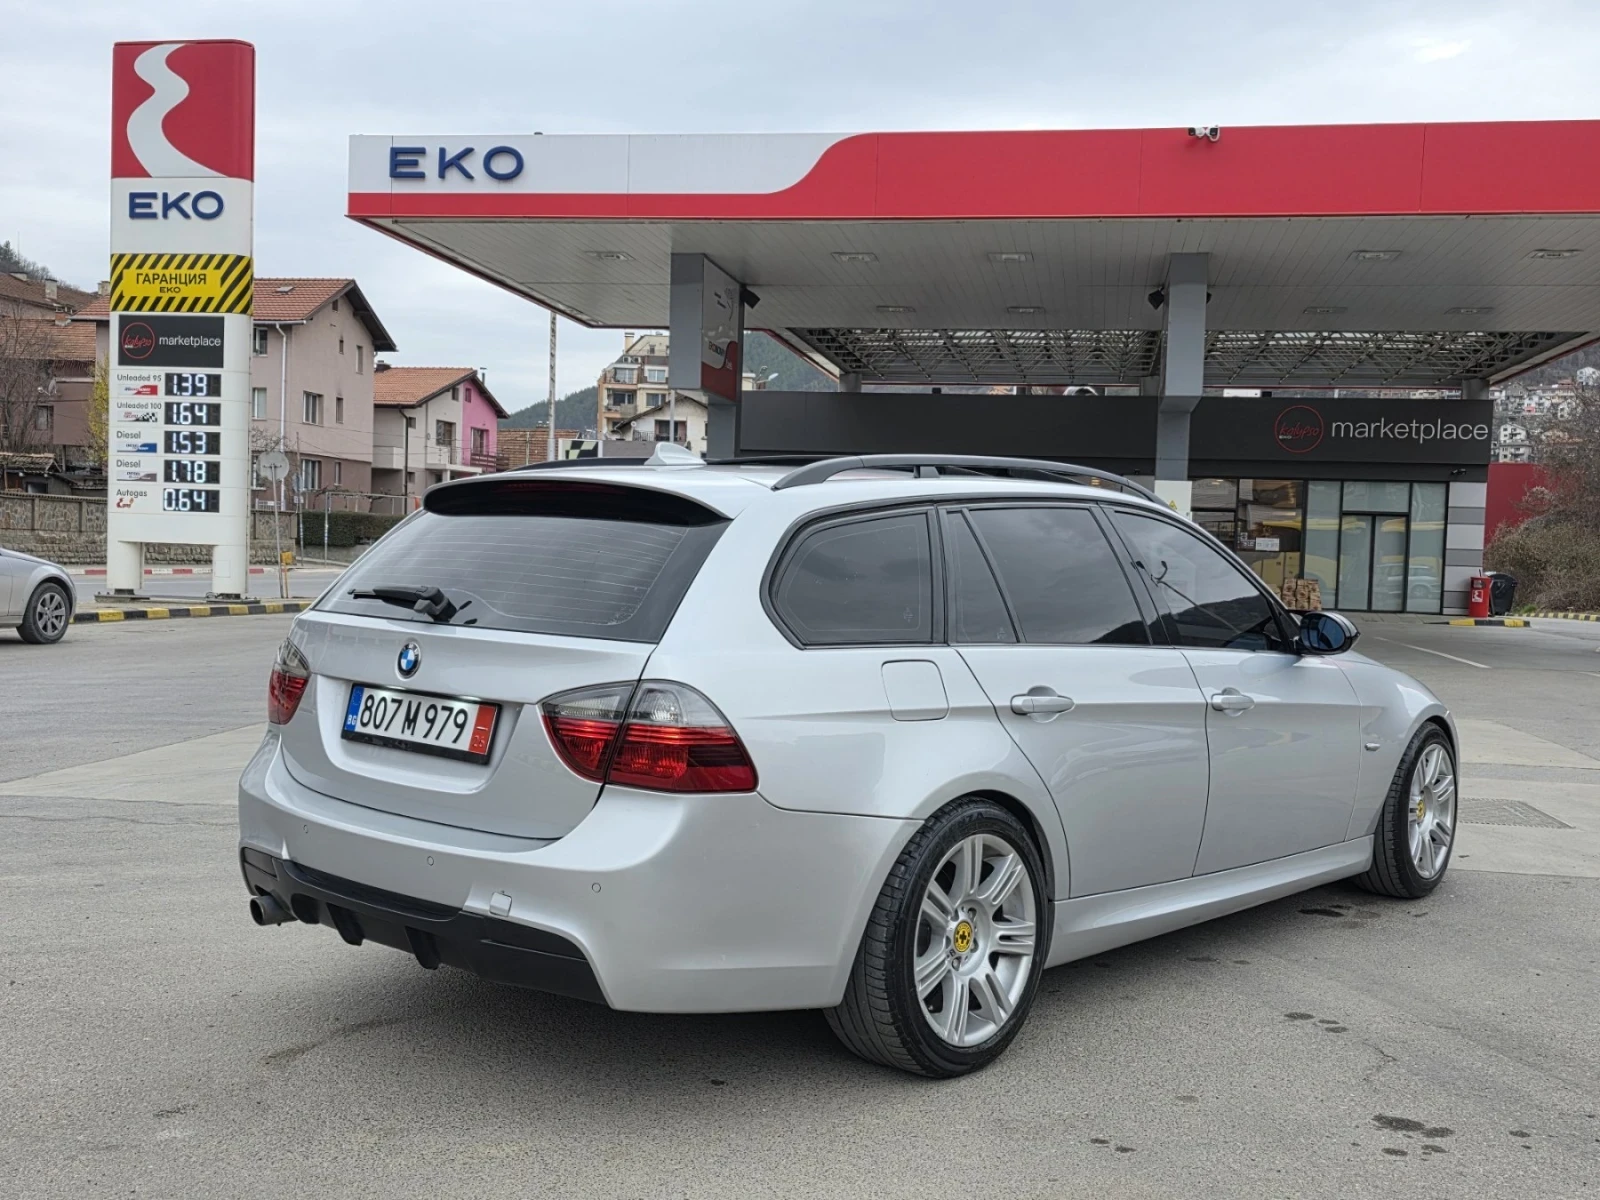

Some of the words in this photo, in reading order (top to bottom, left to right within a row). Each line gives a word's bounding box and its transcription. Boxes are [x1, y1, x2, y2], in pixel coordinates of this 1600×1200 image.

[389, 146, 525, 181] EKO
[129, 191, 224, 220] EKO
[136, 273, 207, 286] ГАРАНЦИЯ
[159, 335, 222, 348] marketplace
[117, 374, 151, 382] Unleaded
[117, 402, 149, 410] Unleaded
[116, 430, 141, 439] Diesel
[1331, 417, 1489, 444] marketplace
[116, 459, 141, 468] Diesel
[116, 489, 148, 499] Autogas
[347, 714, 357, 726] BG
